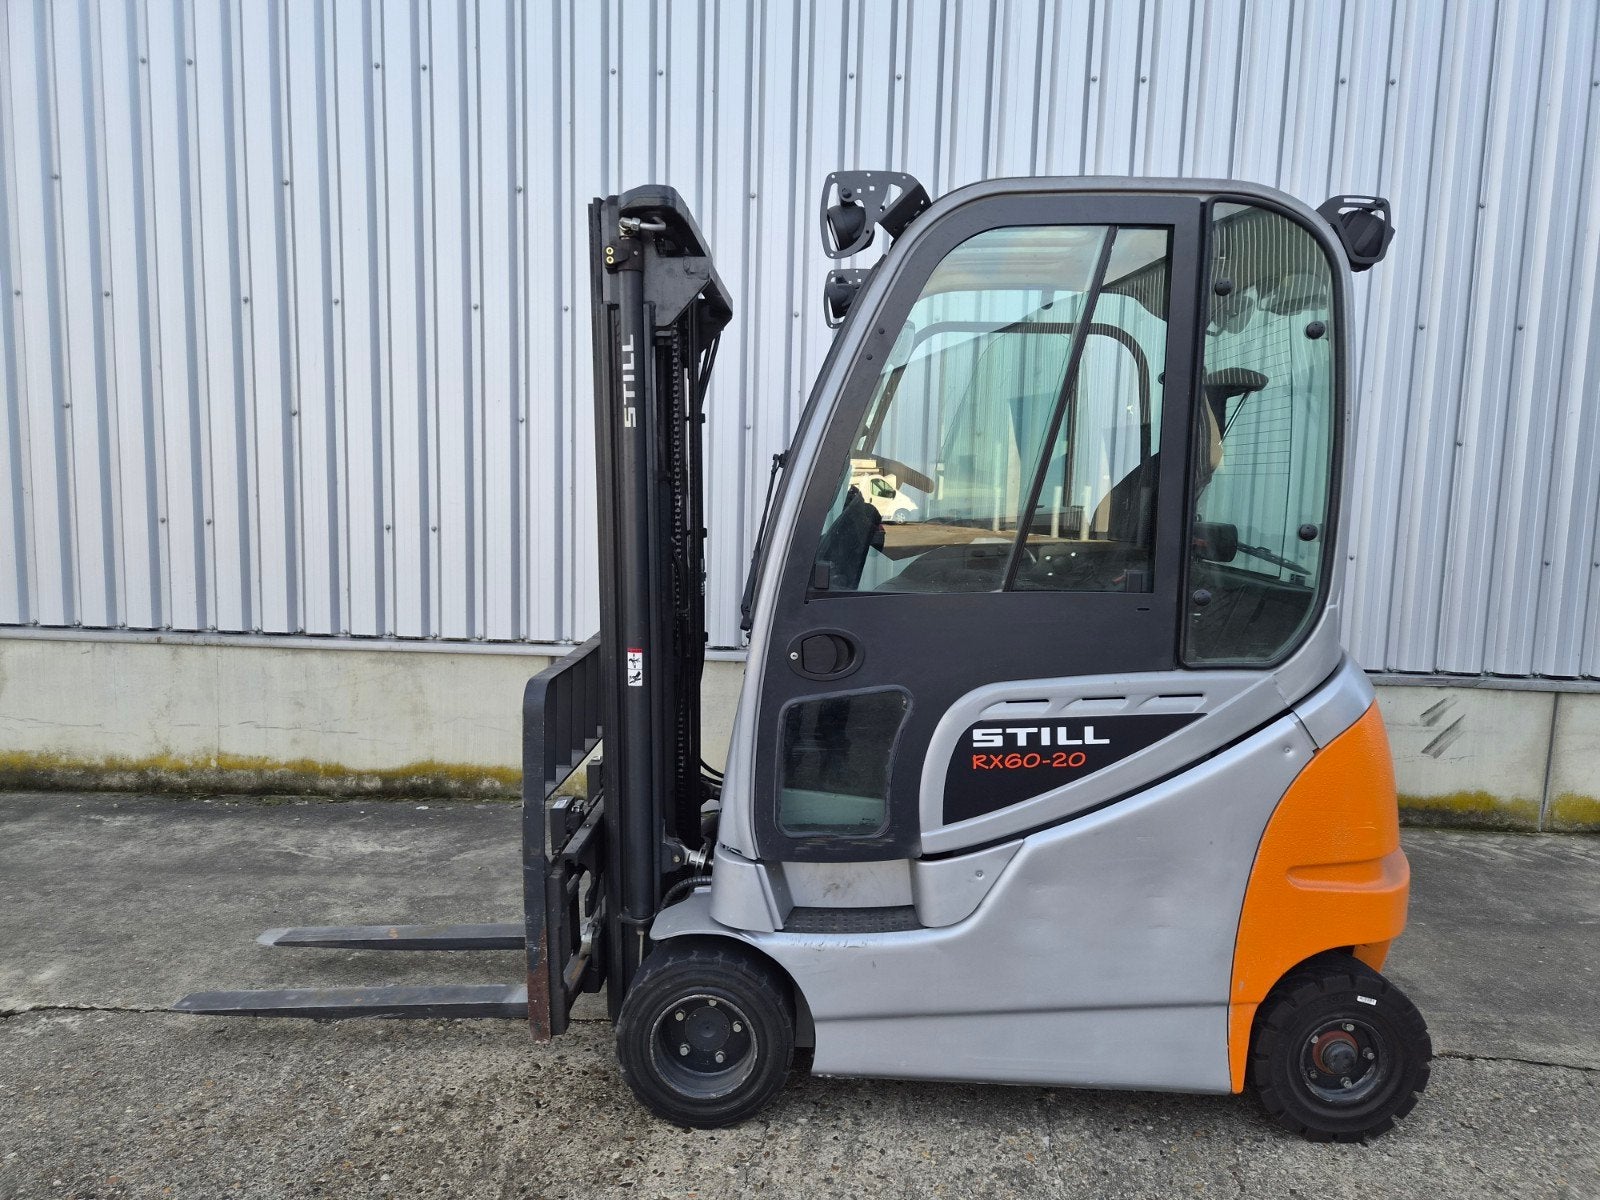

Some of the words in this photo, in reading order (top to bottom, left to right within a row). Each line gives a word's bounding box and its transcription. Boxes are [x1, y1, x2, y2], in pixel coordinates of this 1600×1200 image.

[622, 334, 637, 428] STILL
[972, 725, 1110, 748] STILL
[972, 752, 1087, 770] RX60-20
